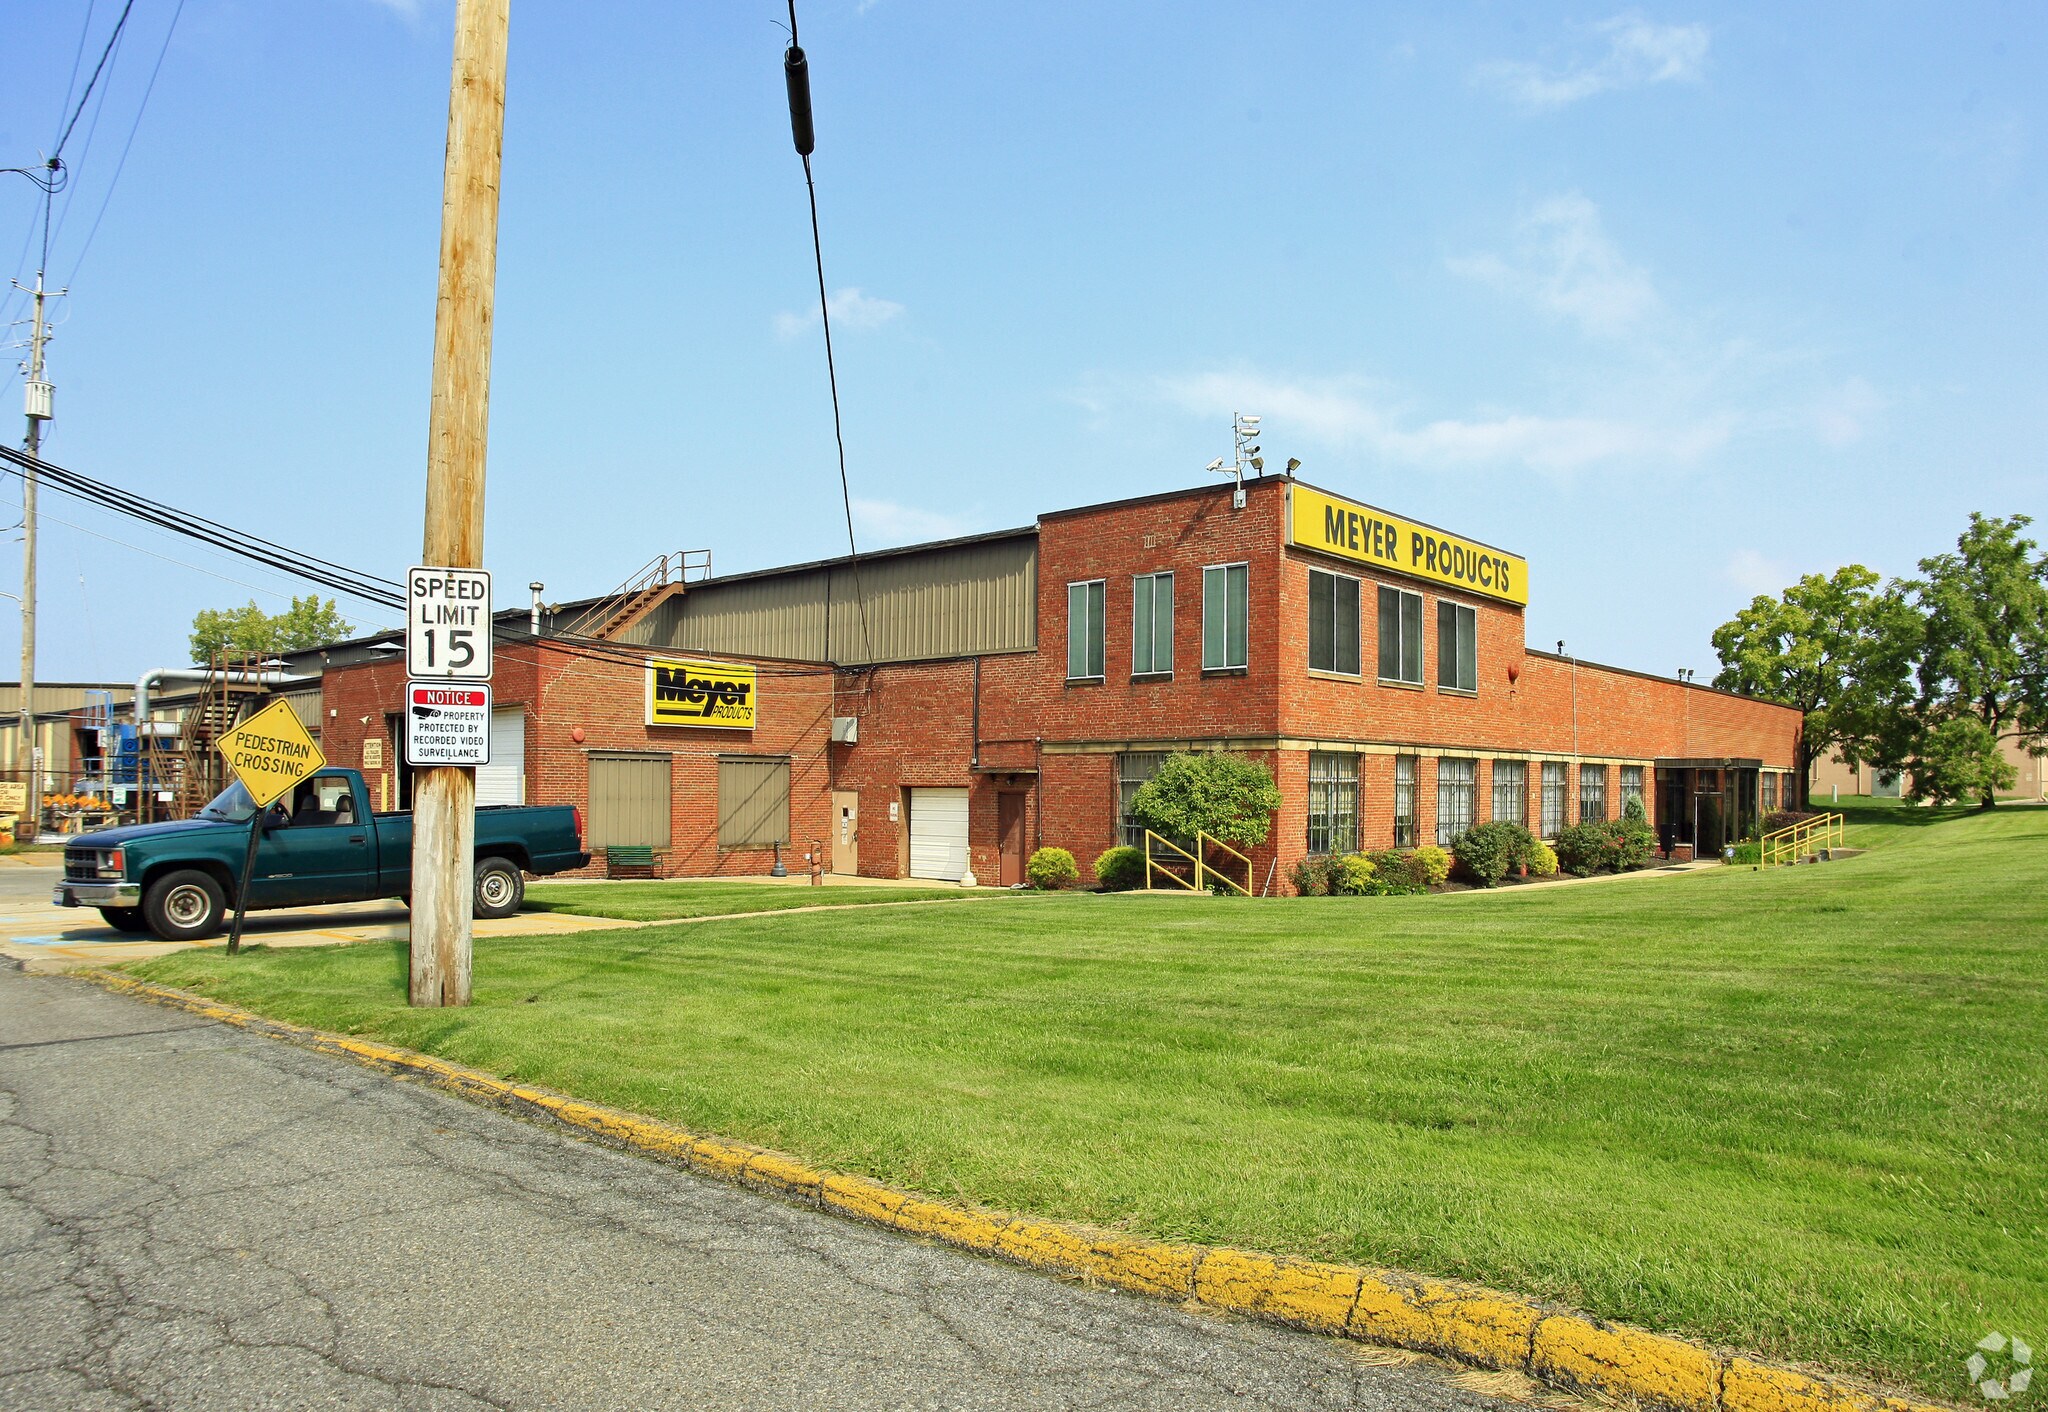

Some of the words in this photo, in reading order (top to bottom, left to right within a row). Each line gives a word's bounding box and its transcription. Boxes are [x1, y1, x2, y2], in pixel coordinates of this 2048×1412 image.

[1325, 504, 1398, 562] MEYER
[1411, 532, 1509, 593] PRODUCTS
[413, 577, 485, 600] SPEED
[422, 604, 479, 625] LIMIT
[424, 629, 475, 668] 15
[427, 691, 472, 705] NOTICE
[656, 667, 751, 717] Meyer
[443, 711, 485, 721] PROPERTY
[711, 705, 753, 720] PRODUCTS
[419, 723, 465, 733] PROTECTED
[468, 724, 479, 733] BY
[235, 732, 310, 759] PEDESTRIAN
[413, 735, 457, 745] RECORDED
[460, 736, 484, 746] VIDEO
[418, 748, 479, 757] SURVEILLANCE
[234, 752, 304, 777] CROSSING
